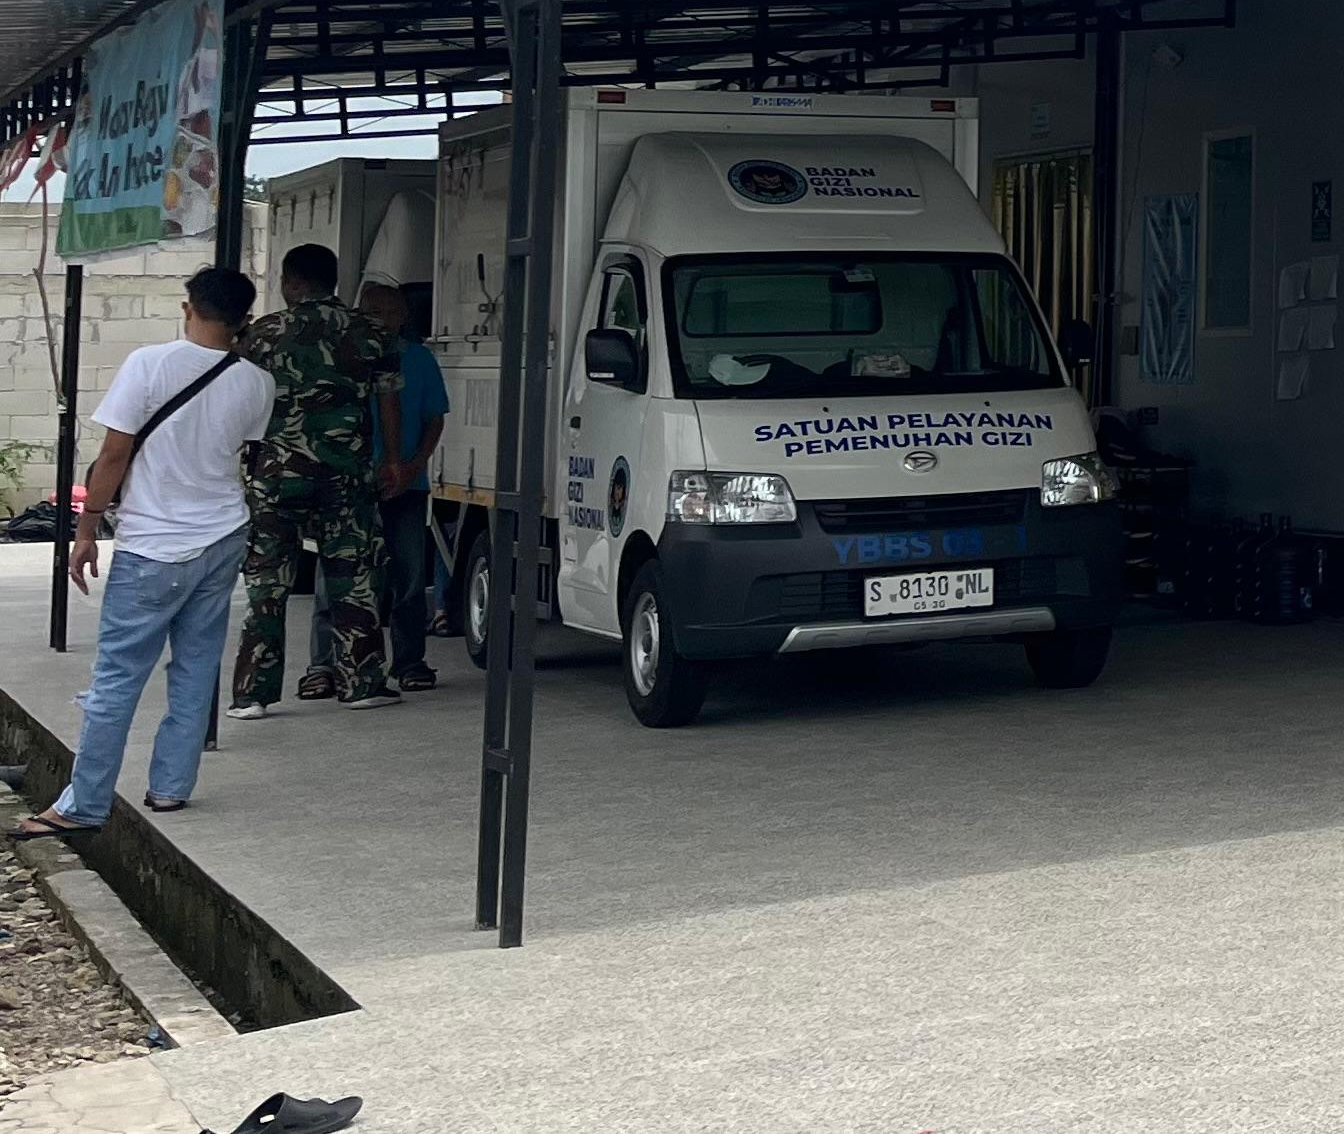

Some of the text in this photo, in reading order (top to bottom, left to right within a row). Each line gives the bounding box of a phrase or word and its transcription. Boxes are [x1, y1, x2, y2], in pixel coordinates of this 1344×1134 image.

[805, 167, 876, 177] BADAN
[809, 177, 851, 187] GIZI
[813, 187, 921, 198] NASIONAL
[754, 412, 1053, 443] SATUAN PELAYANAN
[784, 431, 1033, 457] PEMENUHAN GIZI
[568, 456, 595, 479] BADAN
[568, 481, 584, 503] GIZI
[832, 530, 933, 565] YBBS
[870, 573, 989, 602] S 8130 NL
